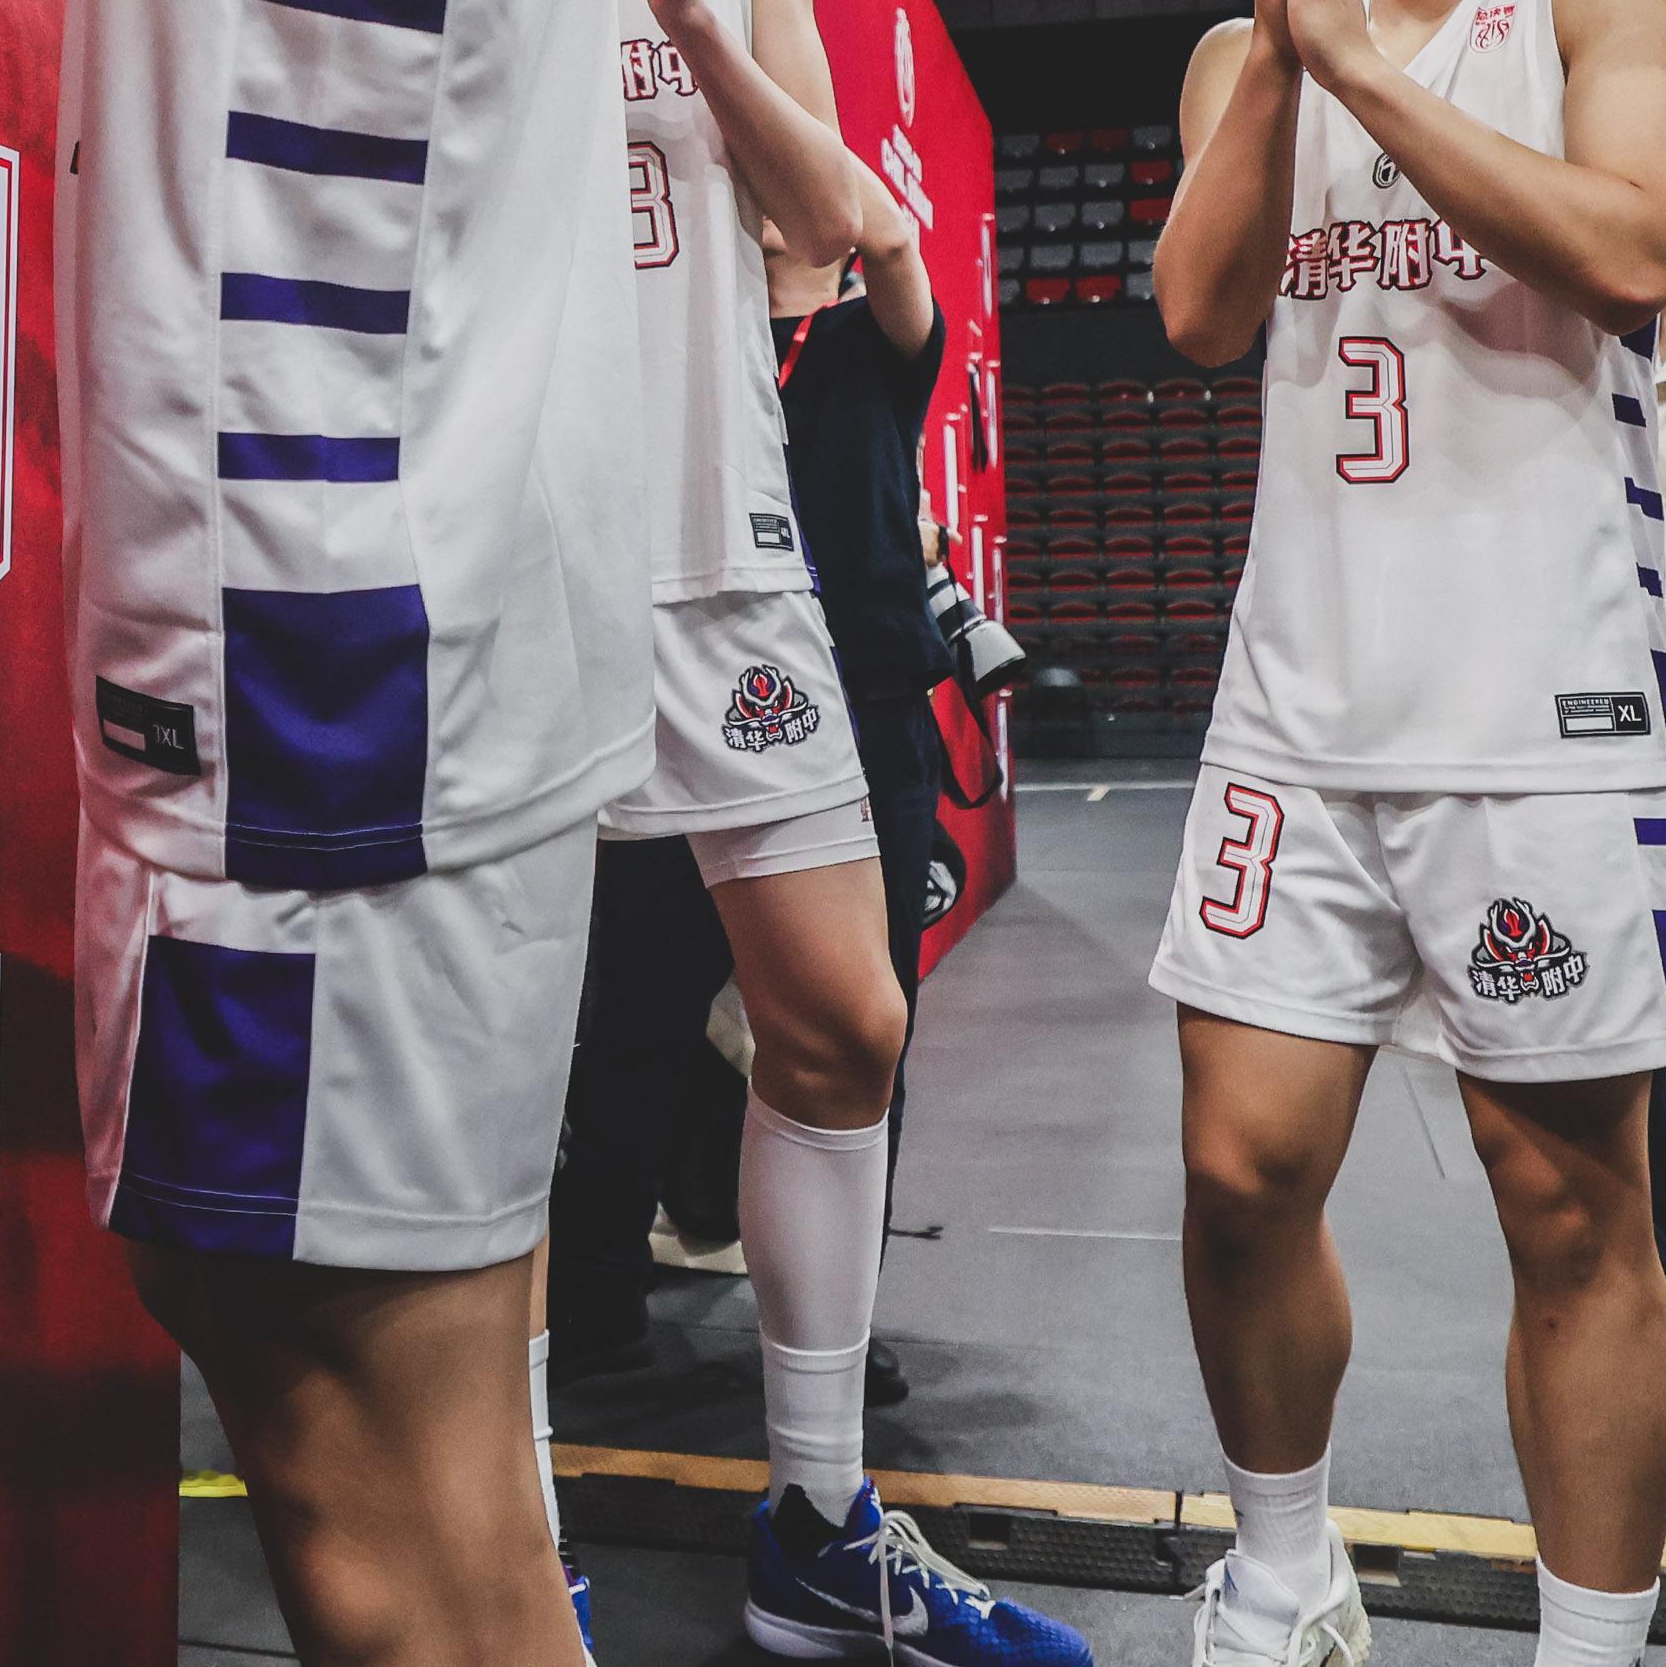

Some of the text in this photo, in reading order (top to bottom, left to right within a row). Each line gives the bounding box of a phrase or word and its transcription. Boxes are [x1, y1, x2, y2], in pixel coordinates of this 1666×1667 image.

[1335, 336, 1411, 485] 3
[725, 709, 819, 749] 清华附中
[1617, 704, 1642, 723] XL
[1199, 782, 1285, 941] 3
[1469, 954, 1586, 1001] 清华附中
